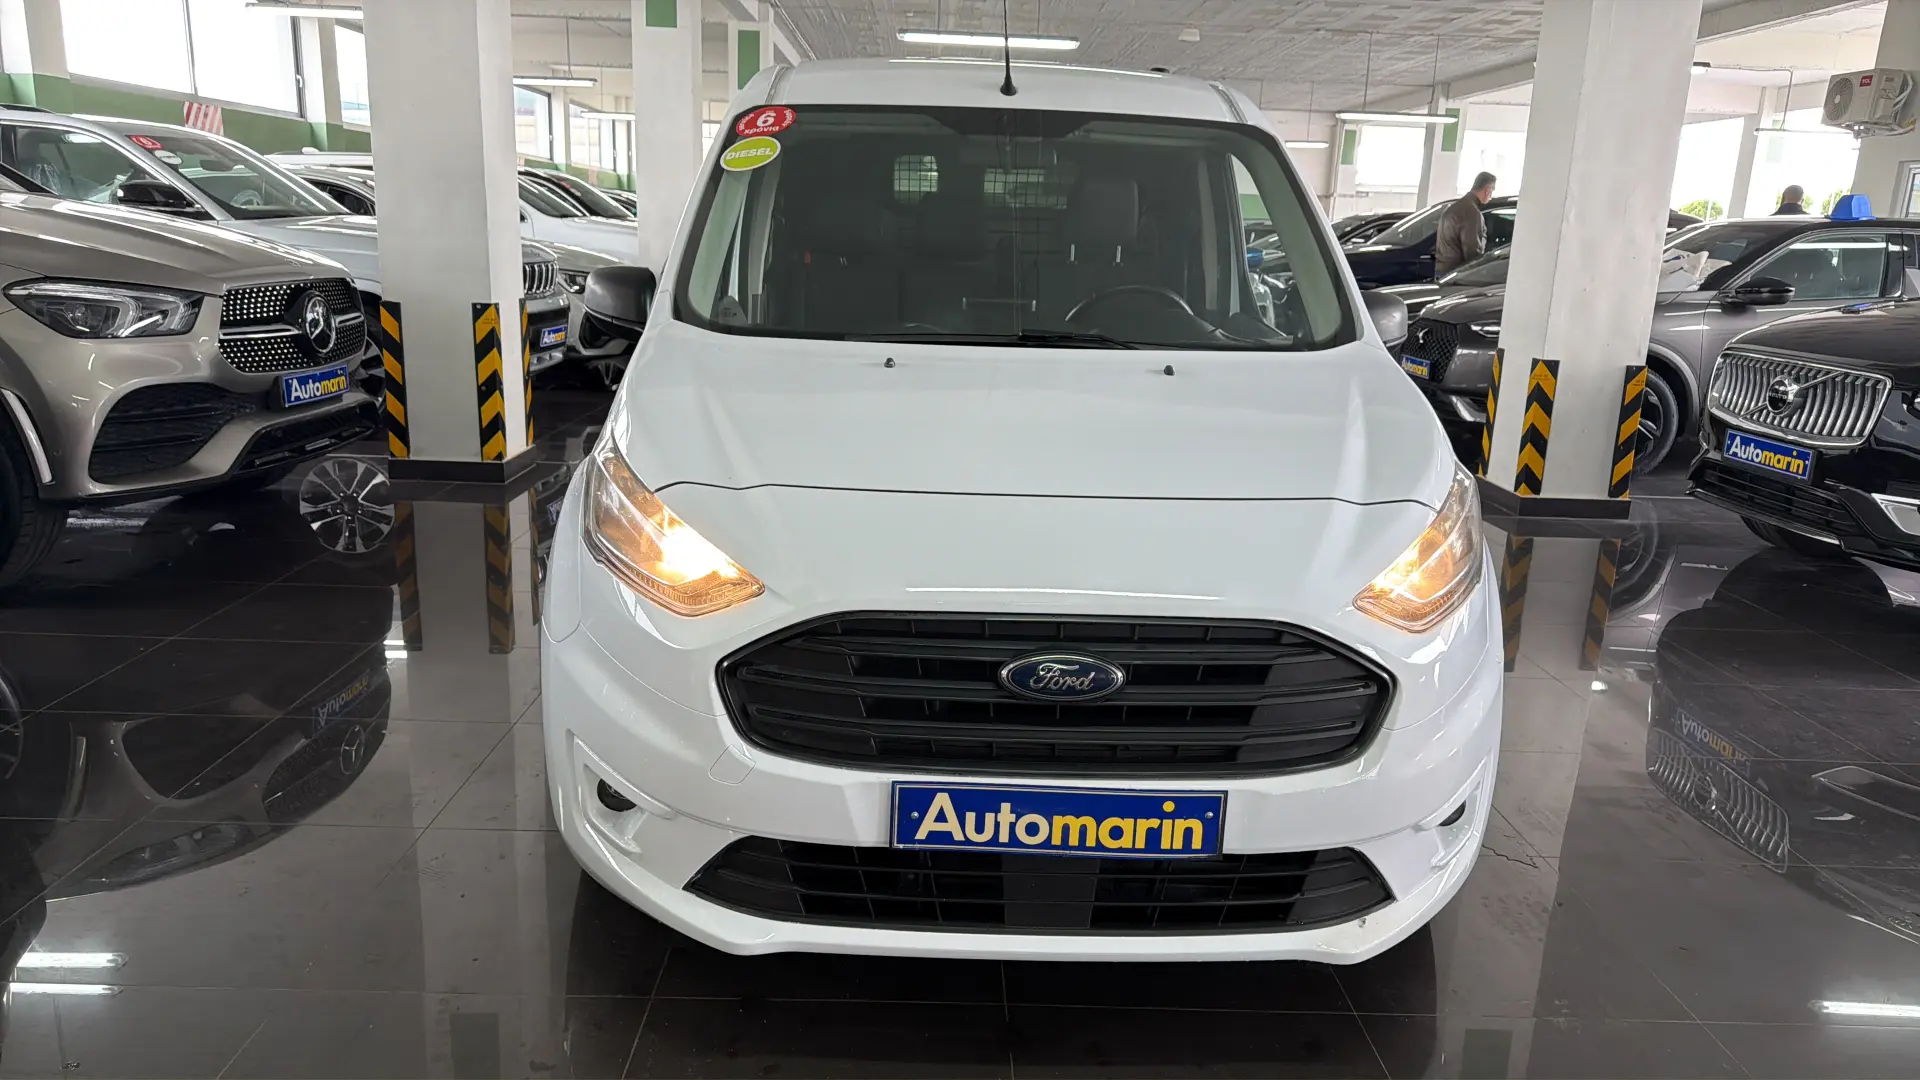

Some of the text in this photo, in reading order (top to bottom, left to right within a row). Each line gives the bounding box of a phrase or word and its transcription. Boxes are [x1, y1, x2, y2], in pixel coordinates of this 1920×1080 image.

[756, 112, 777, 127] 6
[725, 147, 774, 161] DIESEL
[291, 369, 347, 402] Automarin
[1728, 435, 1804, 475] Automarin
[1029, 663, 1095, 691] Ford
[913, 792, 1204, 850] Automarin
